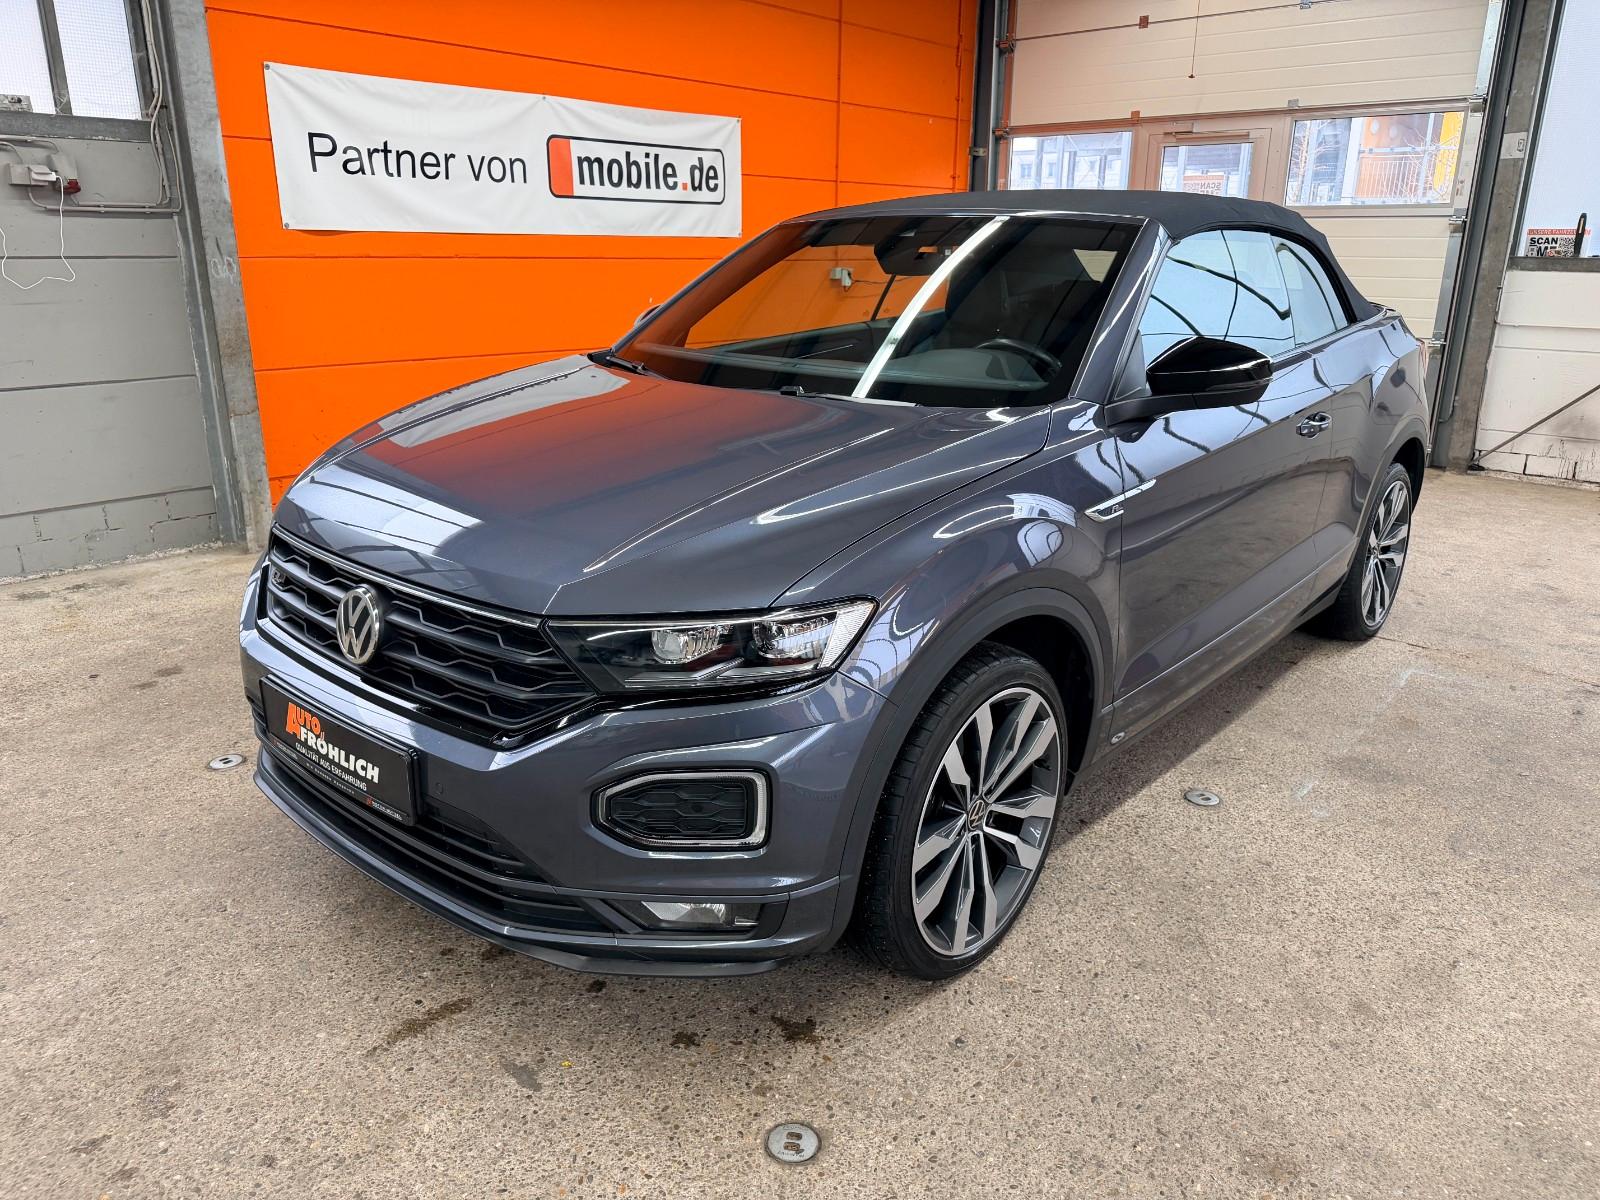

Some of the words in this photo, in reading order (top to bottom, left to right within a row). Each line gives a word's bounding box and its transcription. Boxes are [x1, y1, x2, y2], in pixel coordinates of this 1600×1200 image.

[307, 132, 456, 180] Partner
[467, 154, 527, 184] von
[577, 151, 719, 193] mobile.de
[1530, 237, 1558, 245] SCAN
[286, 702, 321, 740] AUTO
[300, 727, 380, 784] FRÖHLICH
[320, 758, 331, 771] AUS
[331, 765, 367, 791] ERFAHRUNG
